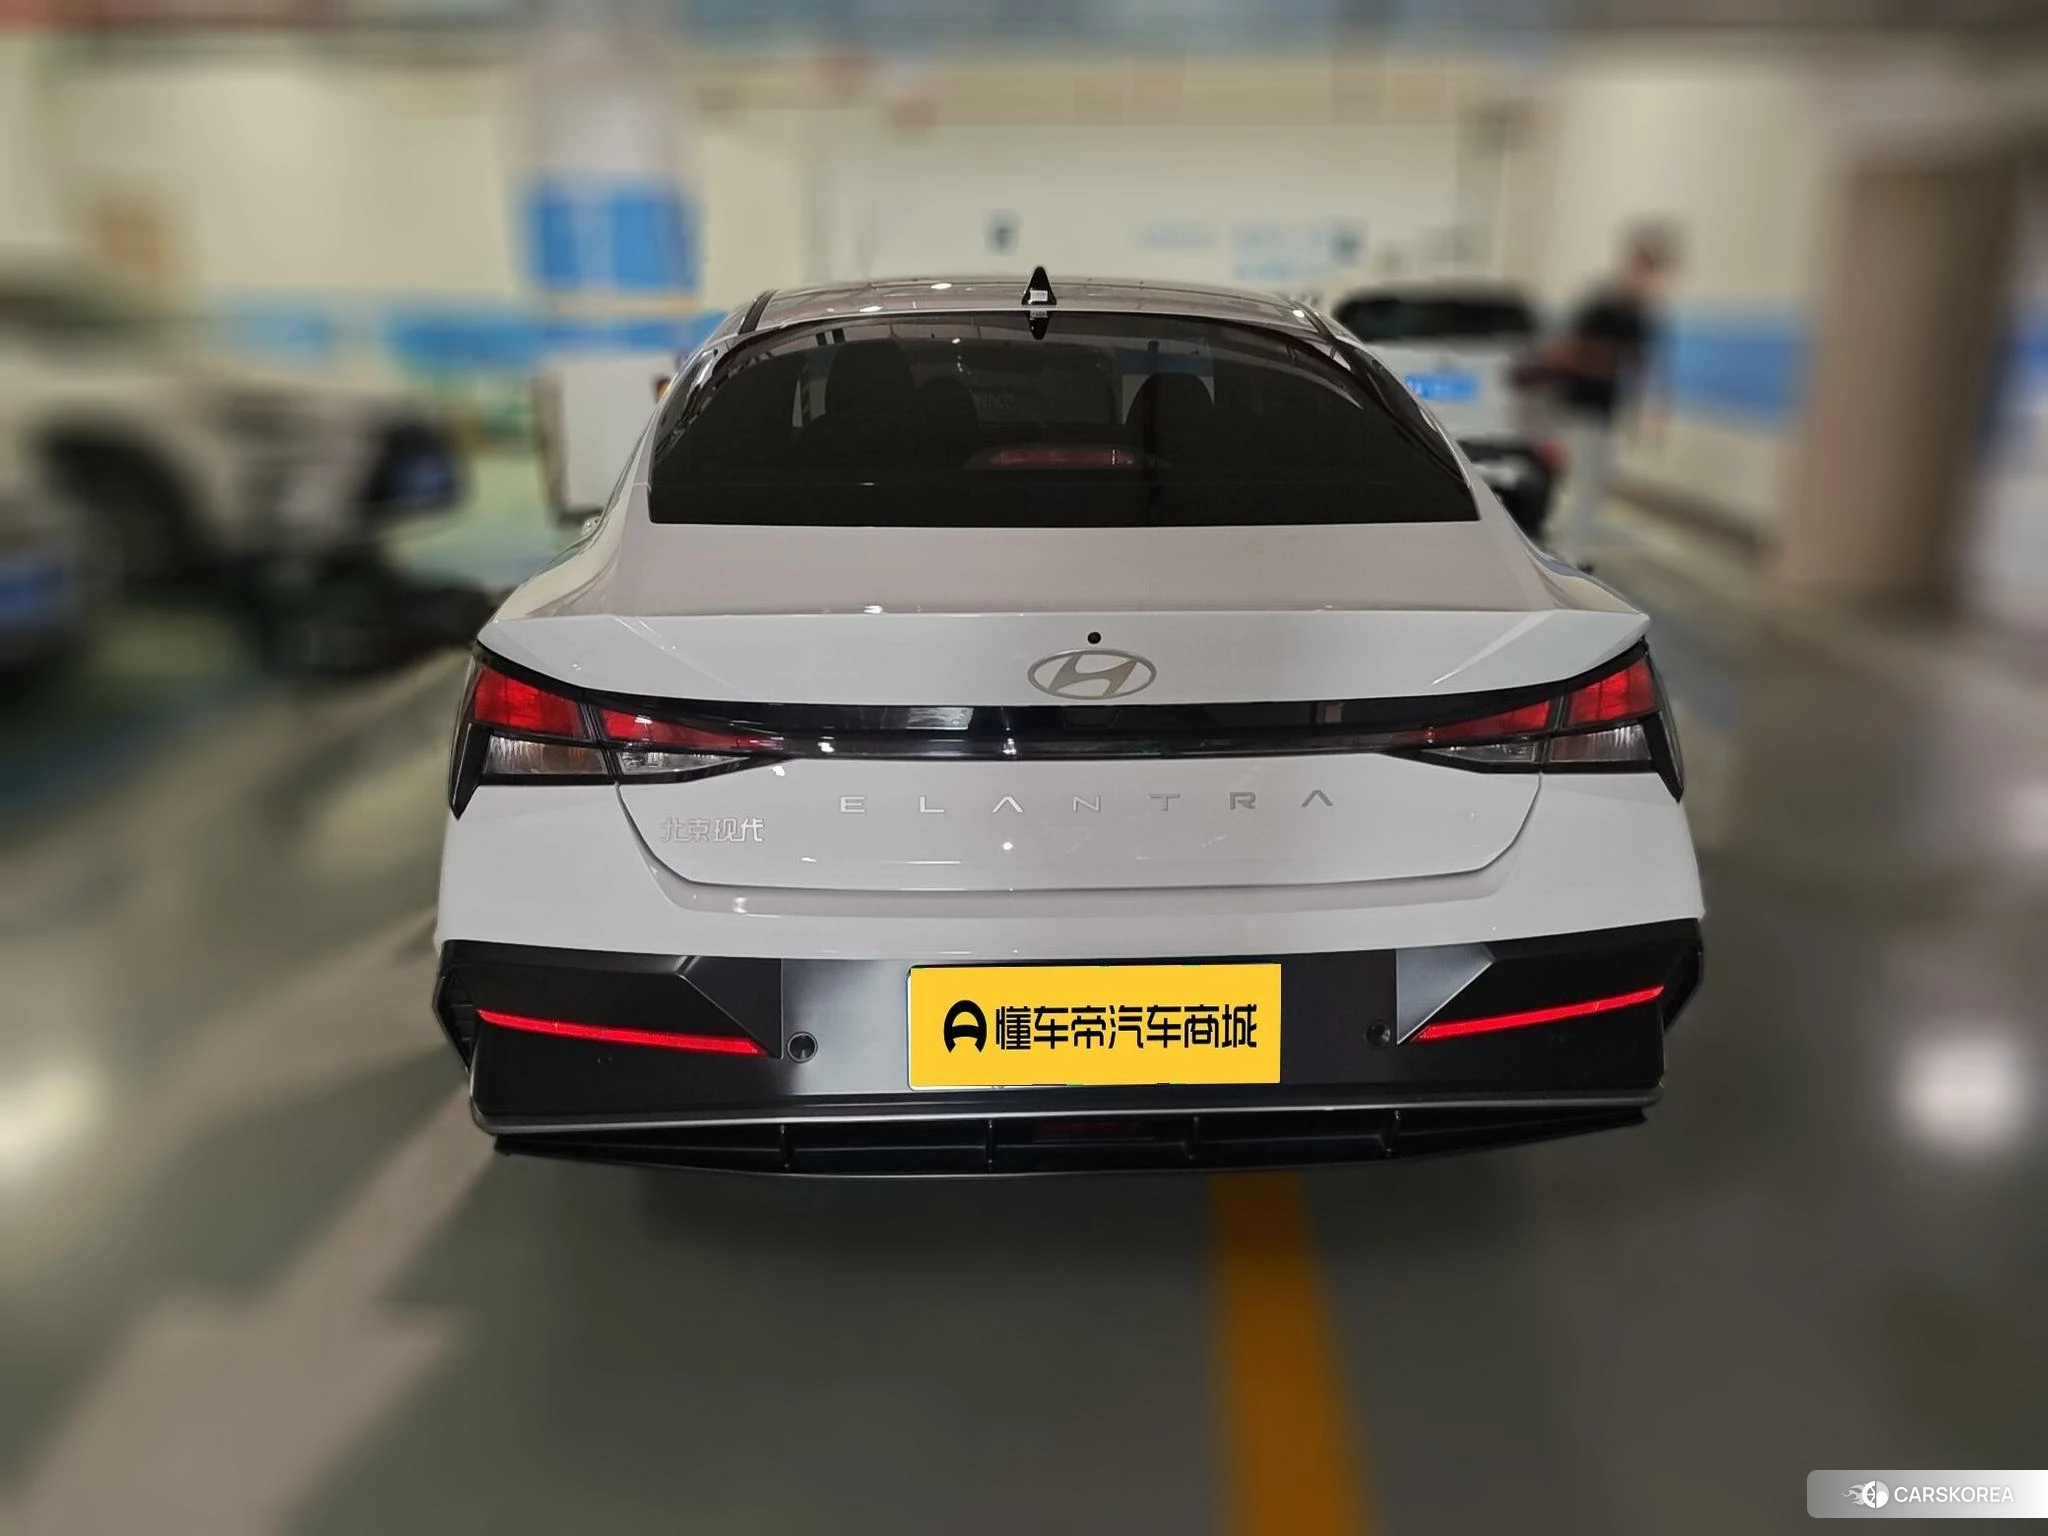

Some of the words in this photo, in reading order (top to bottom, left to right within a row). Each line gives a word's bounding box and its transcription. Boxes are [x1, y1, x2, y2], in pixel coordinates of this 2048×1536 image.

[840, 789, 1334, 814] ELANTRA
[660, 817, 765, 842] 北京现代
